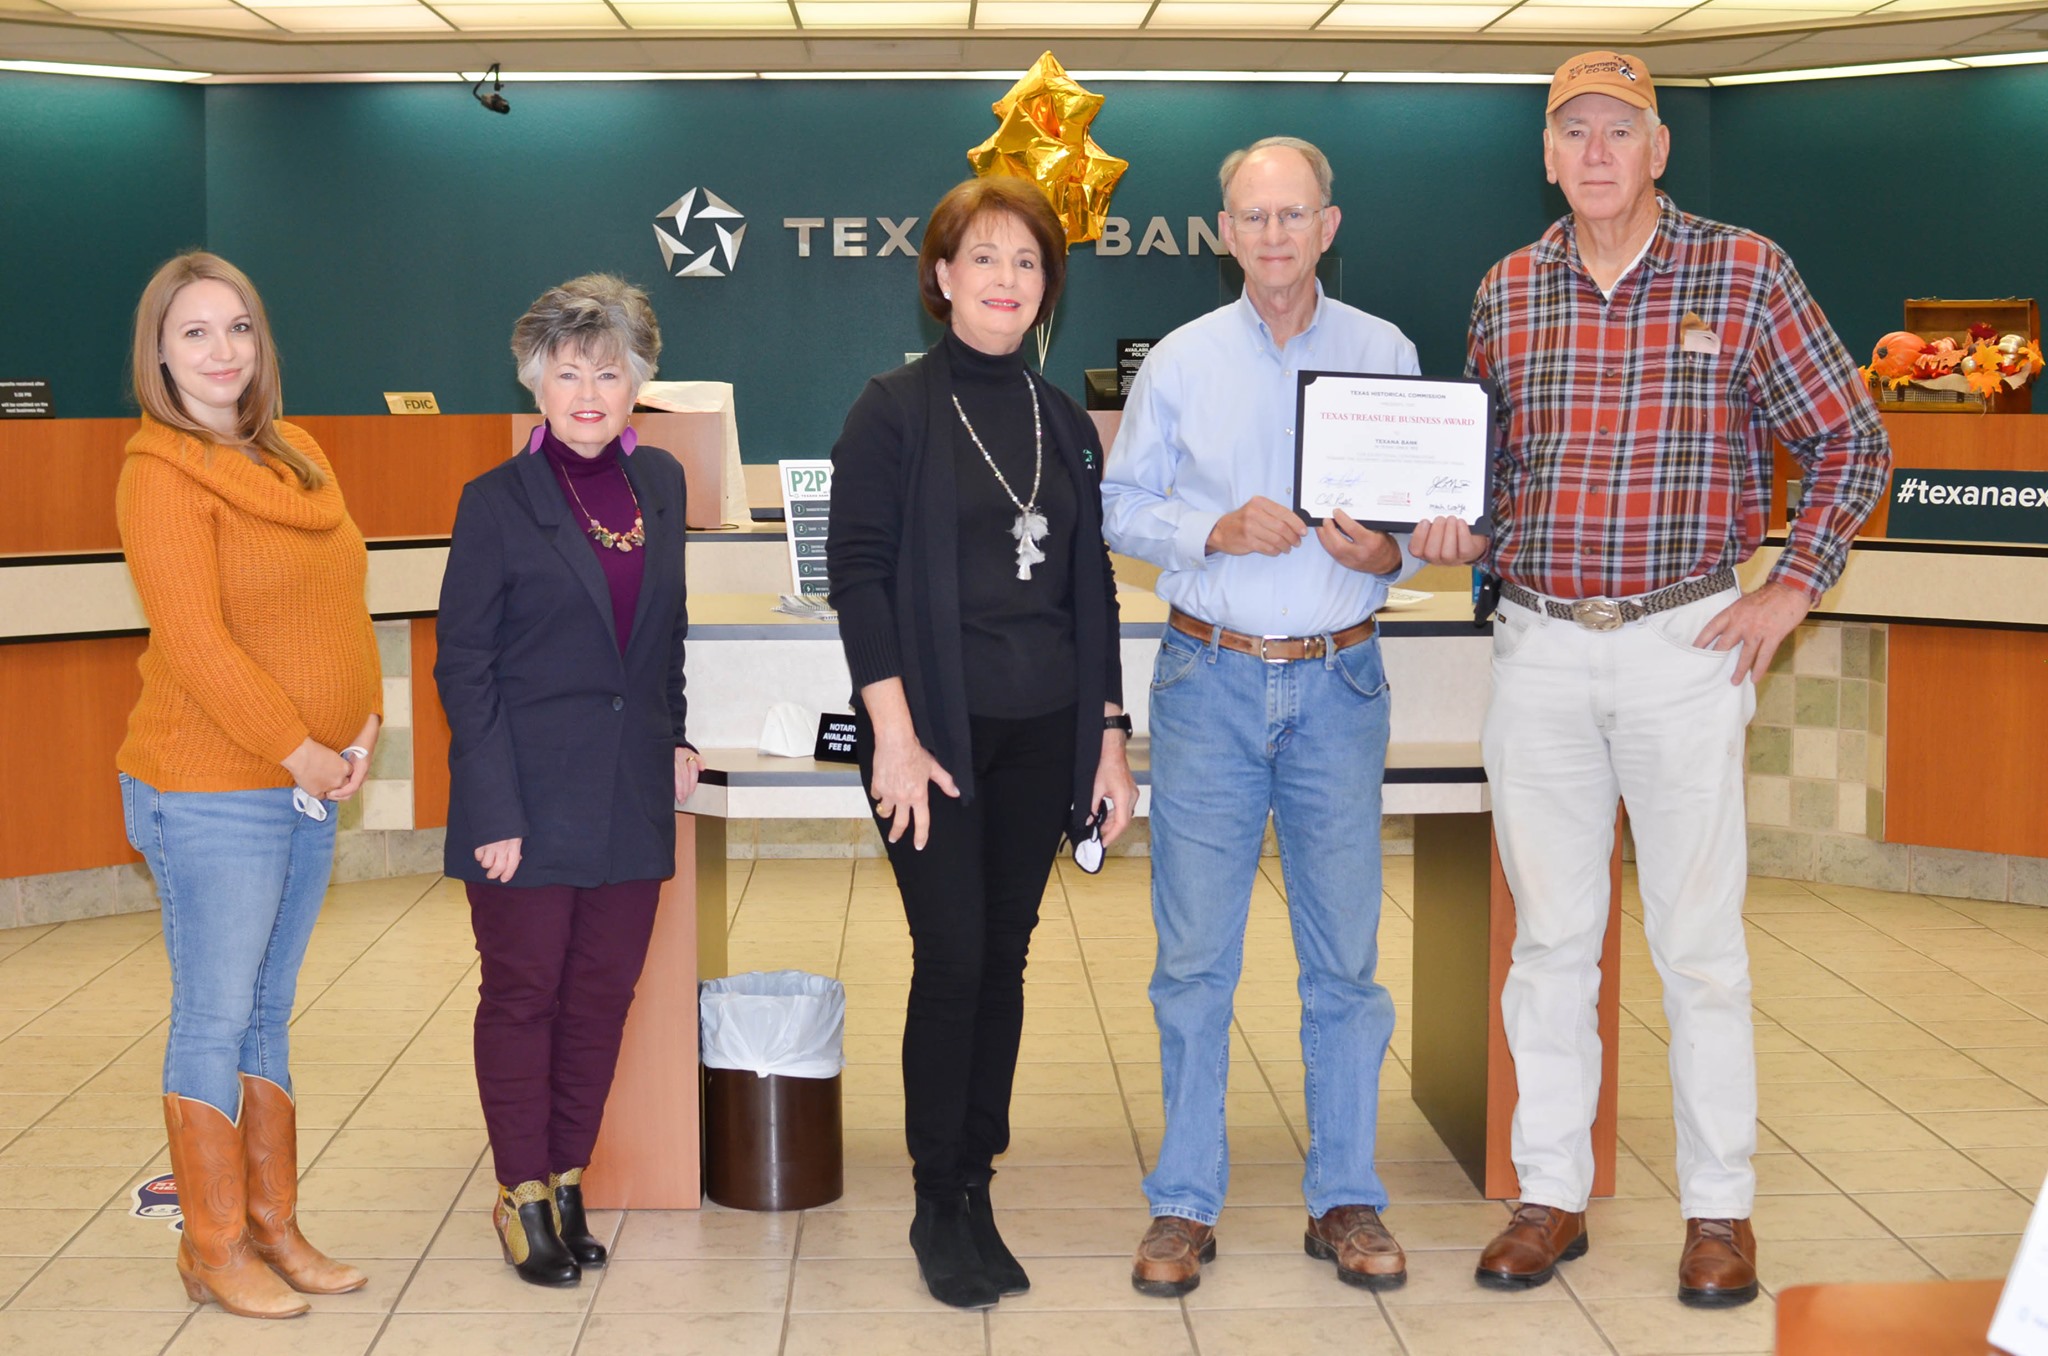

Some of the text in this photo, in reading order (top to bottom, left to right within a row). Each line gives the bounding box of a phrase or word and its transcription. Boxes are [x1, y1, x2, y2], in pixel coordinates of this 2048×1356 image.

[1095, 216, 1230, 256] BAN
[404, 400, 433, 410] FDIC
[1320, 412, 1475, 426] TEXAS TREASURE BUSINESS AWARD
[790, 470, 827, 492] P2P
[1897, 477, 2048, 508] #texanaex
[822, 732, 857, 742] AVAILABL
[828, 743, 842, 751] FEE
